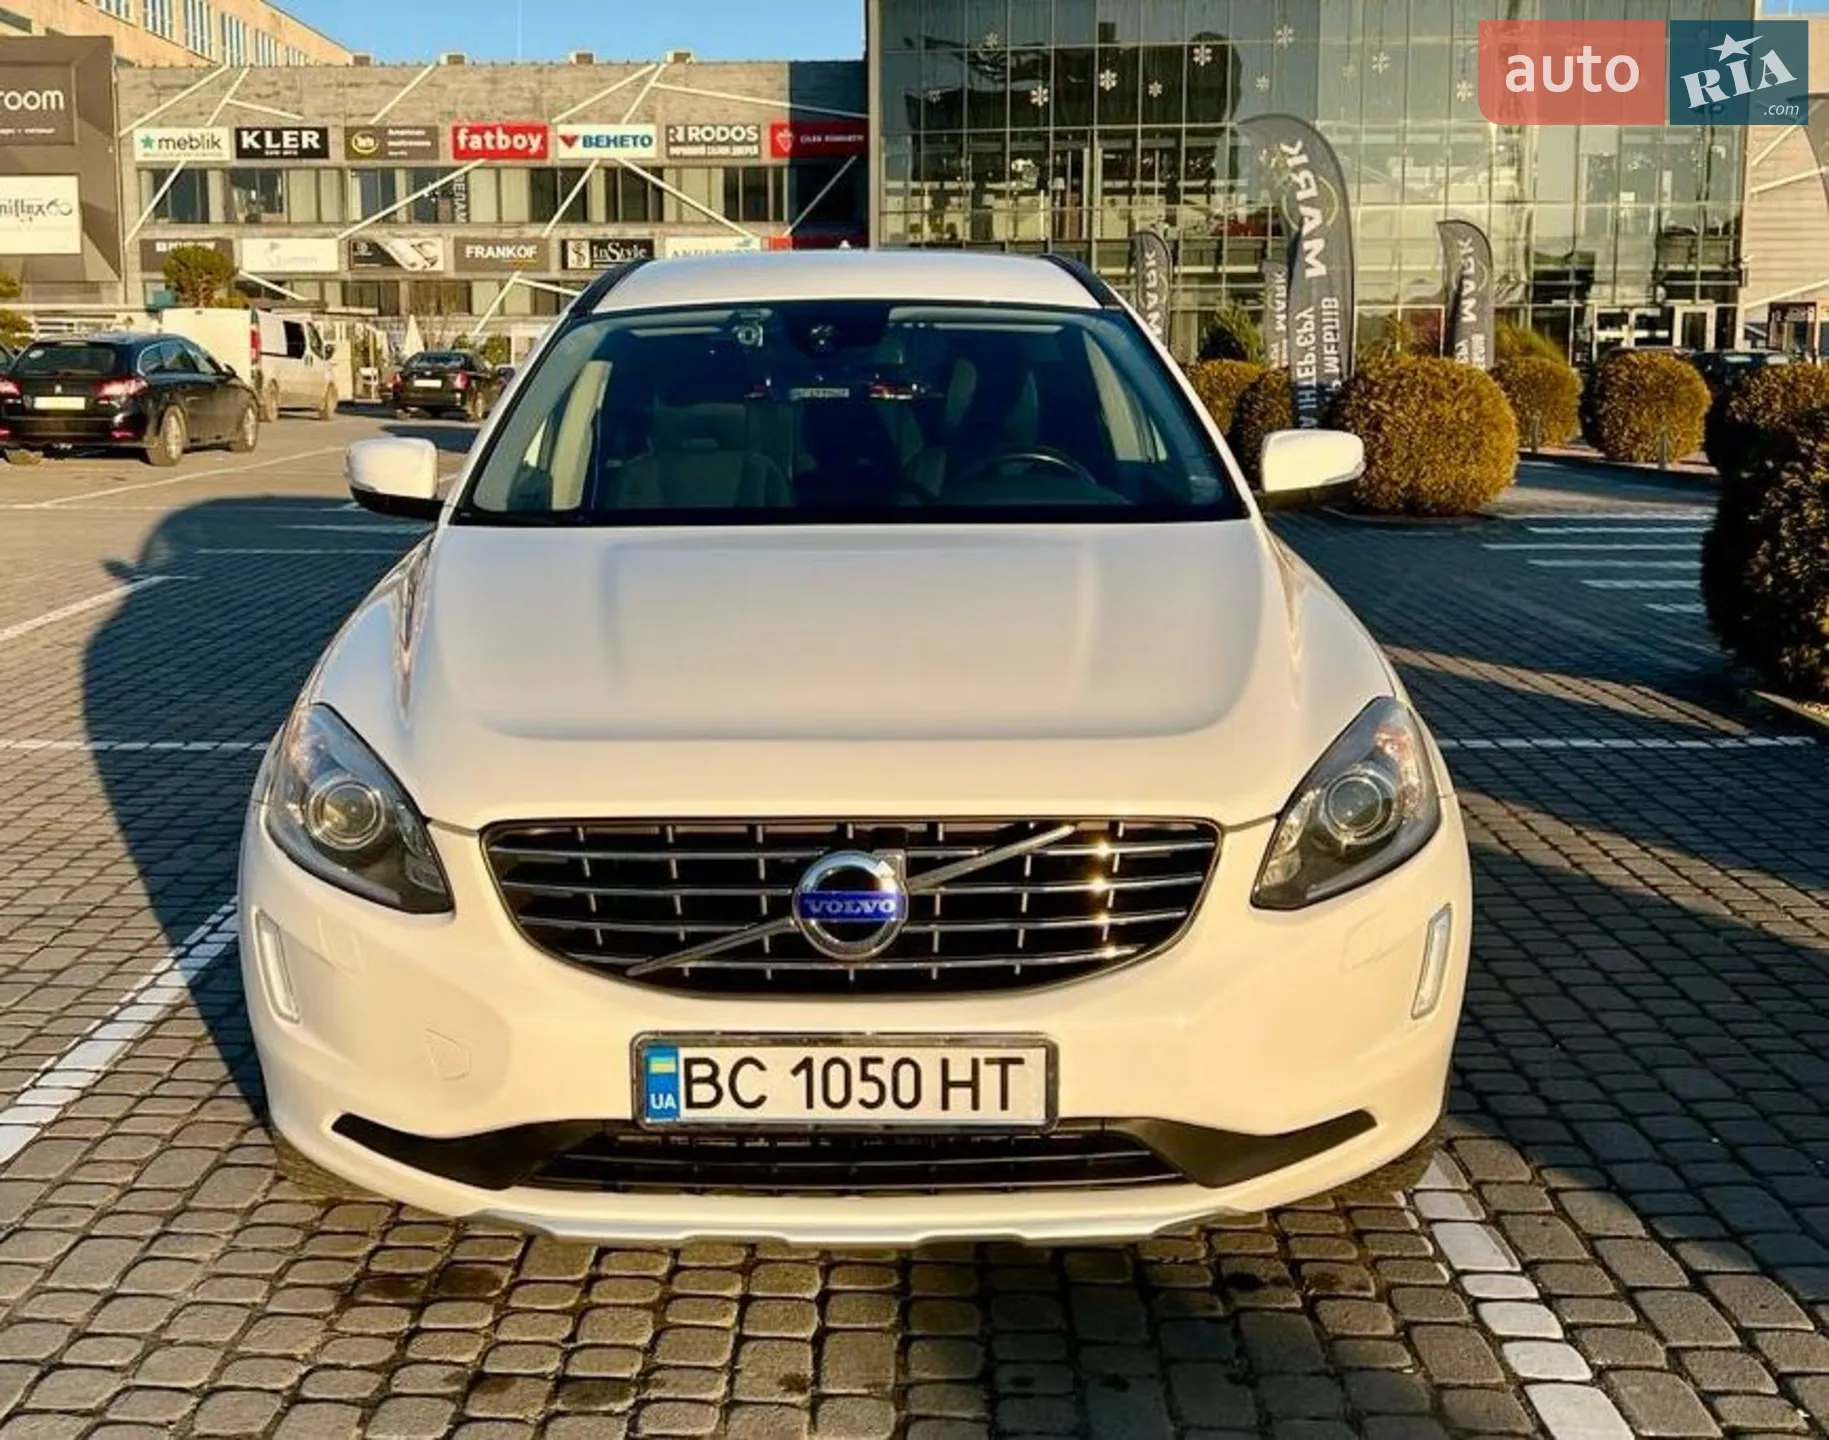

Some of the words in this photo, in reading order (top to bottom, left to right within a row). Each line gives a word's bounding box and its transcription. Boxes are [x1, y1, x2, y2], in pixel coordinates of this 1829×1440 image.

[158, 132, 221, 150] meblik
[241, 130, 321, 149] KLER
[457, 126, 542, 154] fatboy
[687, 126, 759, 142] RODOS
[465, 244, 537, 259] FRANKOF
[804, 899, 896, 913] VOLVO
[684, 1056, 767, 1109] BC
[791, 1056, 921, 1110] 1050
[942, 1057, 1025, 1111] HT
[650, 1093, 677, 1109] UA
